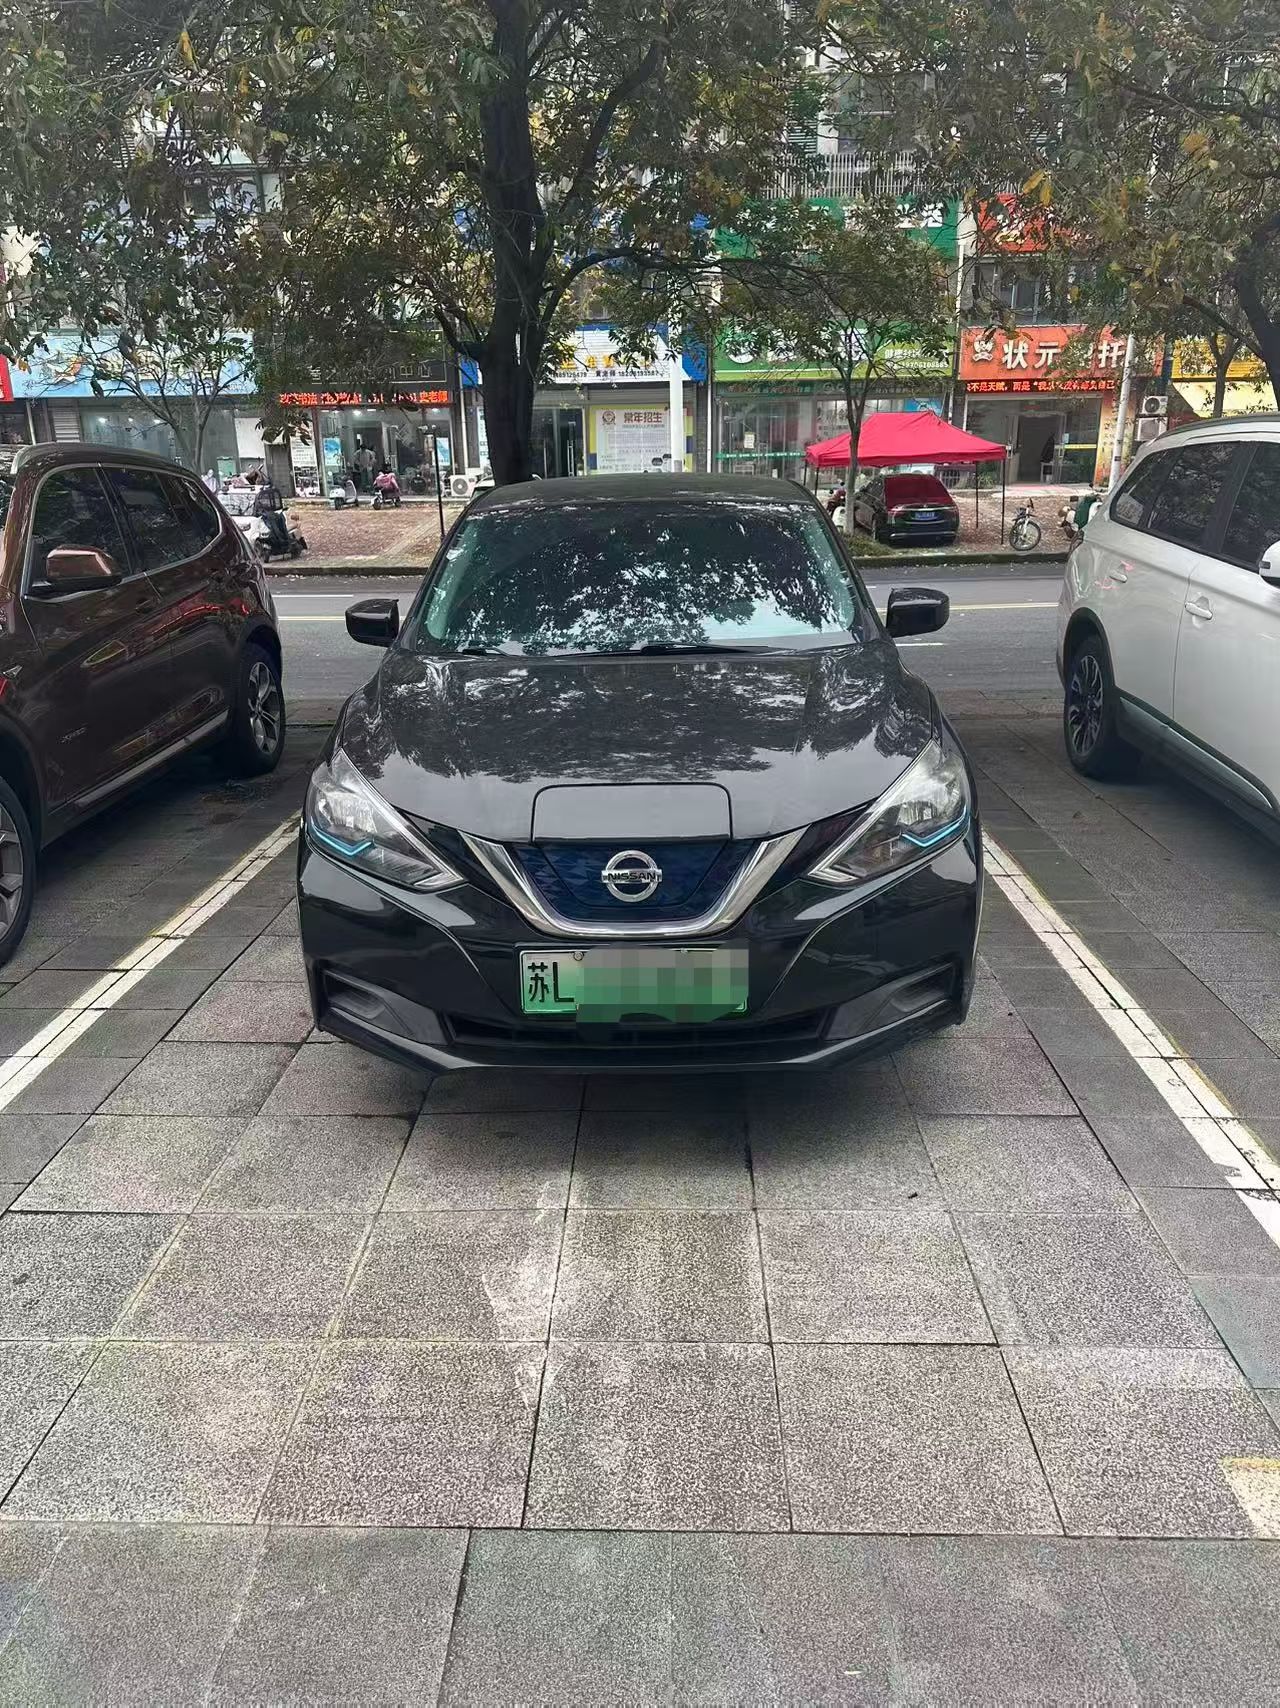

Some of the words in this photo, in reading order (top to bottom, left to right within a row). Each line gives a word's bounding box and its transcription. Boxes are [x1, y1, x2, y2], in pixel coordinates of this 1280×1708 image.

[623, 411, 663, 424] 常年招生
[607, 871, 656, 882] NISSAN
